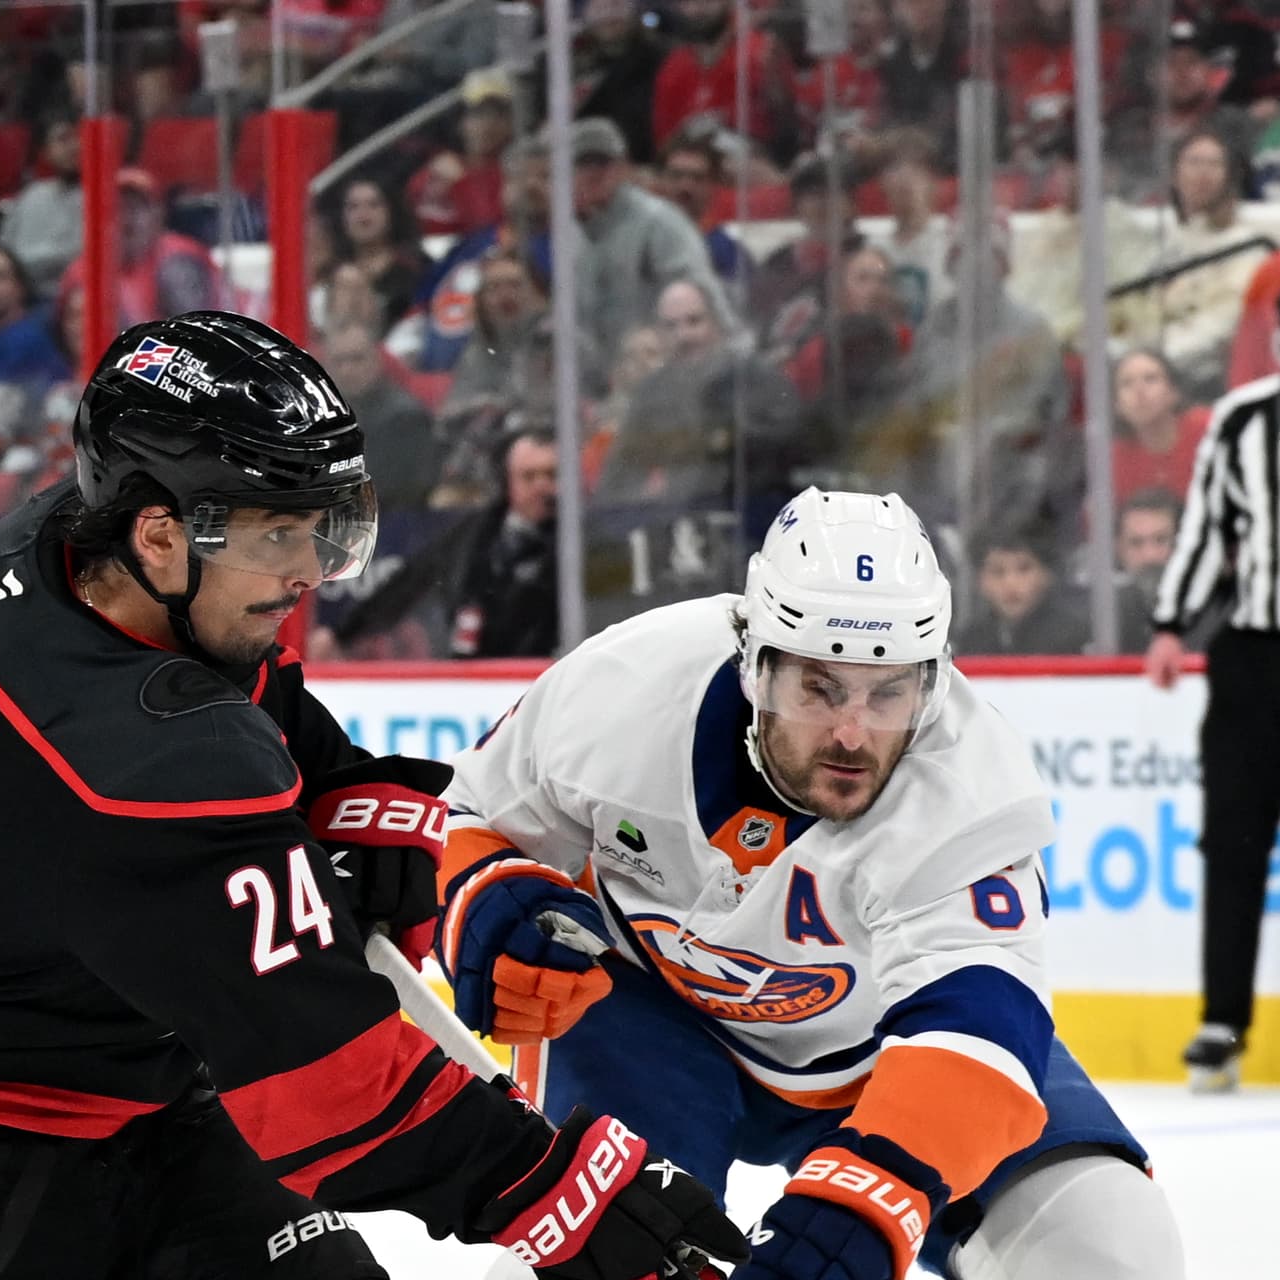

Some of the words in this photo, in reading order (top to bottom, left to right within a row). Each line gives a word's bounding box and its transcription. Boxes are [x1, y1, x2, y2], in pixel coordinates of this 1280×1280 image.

[176, 348, 208, 371] First
[158, 376, 194, 403] Bank
[168, 362, 220, 397] Citizens
[856, 554, 874, 582] 6
[1033, 741, 1094, 788] NC
[225, 844, 334, 976] 24
[784, 864, 846, 946] A
